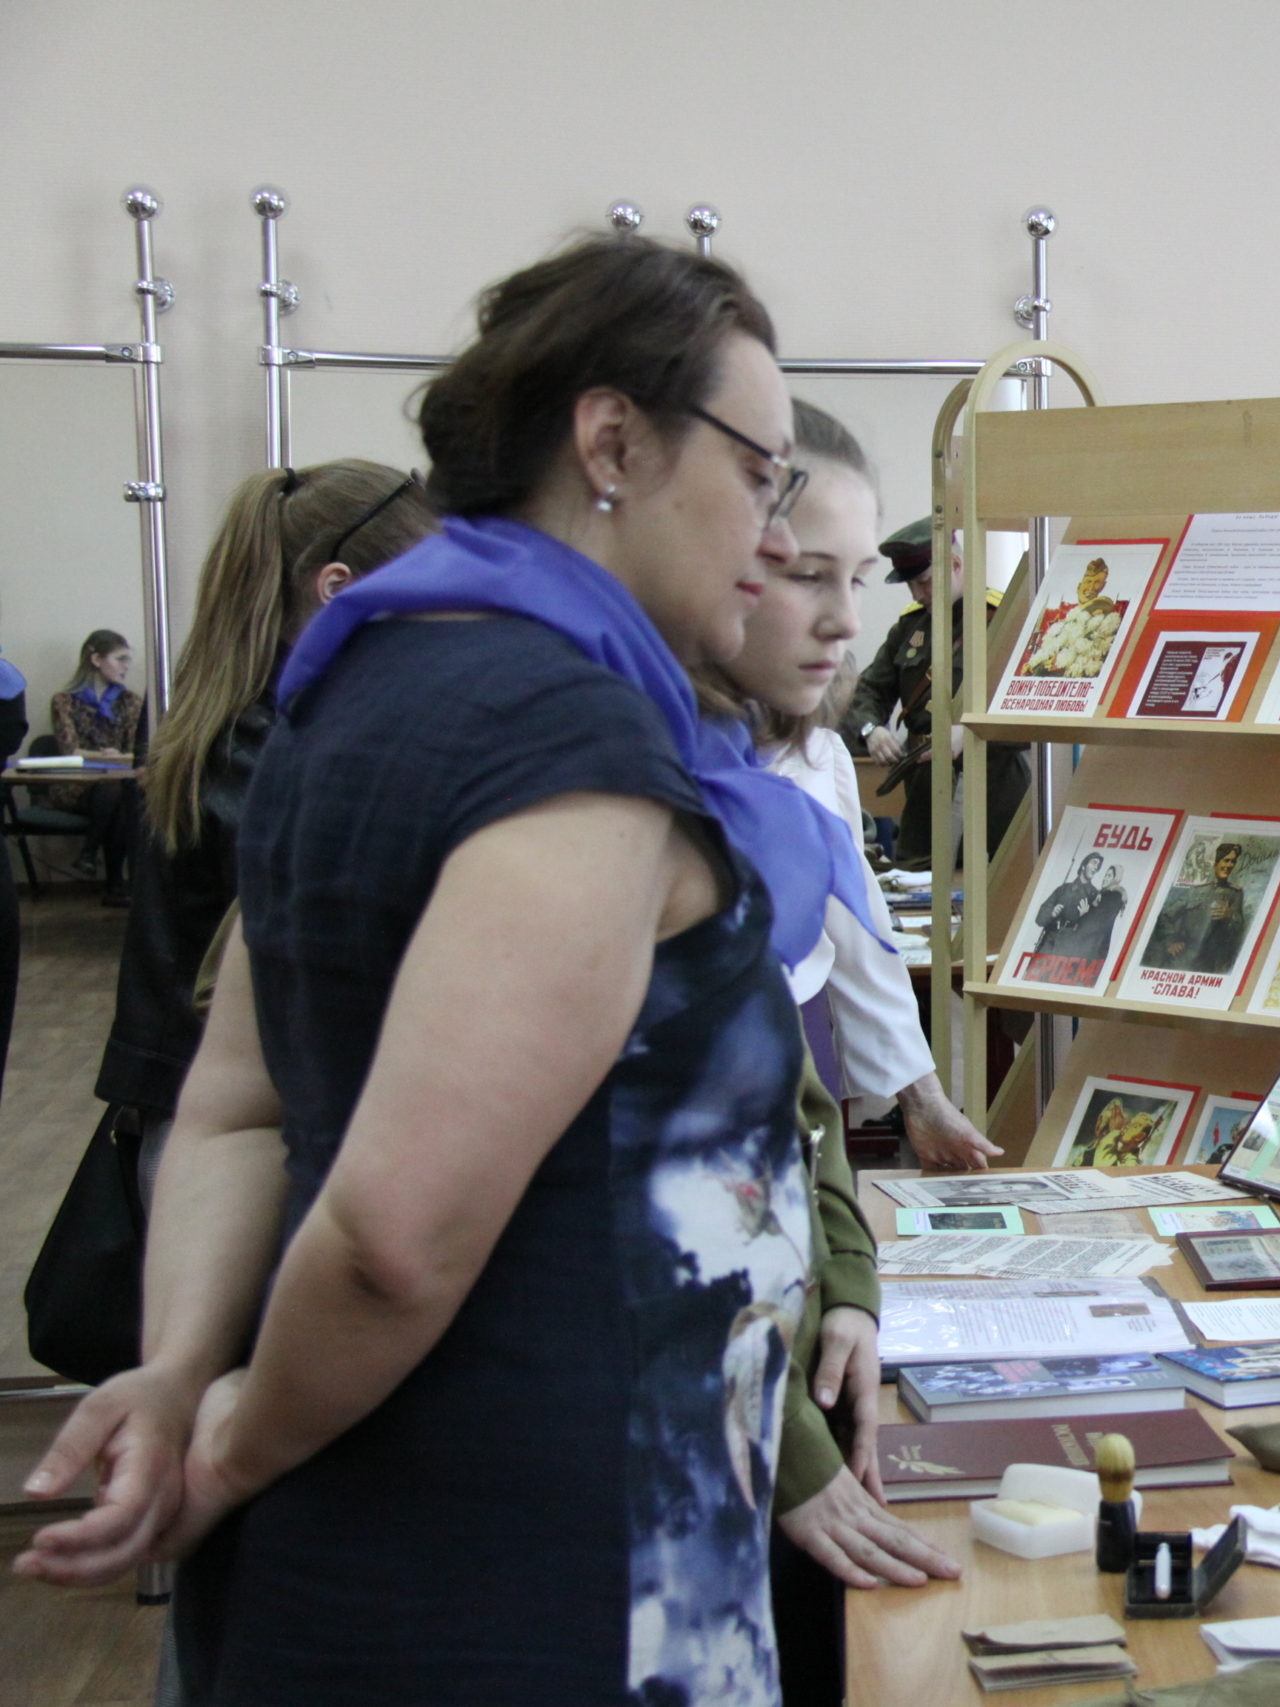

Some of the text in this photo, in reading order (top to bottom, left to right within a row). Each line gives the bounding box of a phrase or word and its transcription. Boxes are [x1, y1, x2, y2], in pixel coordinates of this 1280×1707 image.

[1001, 698, 1054, 711] ВСЕНАРОДНАЯ
[1093, 824, 1153, 851] БУДЬ
[1187, 975, 1223, 988] АРМИИ
